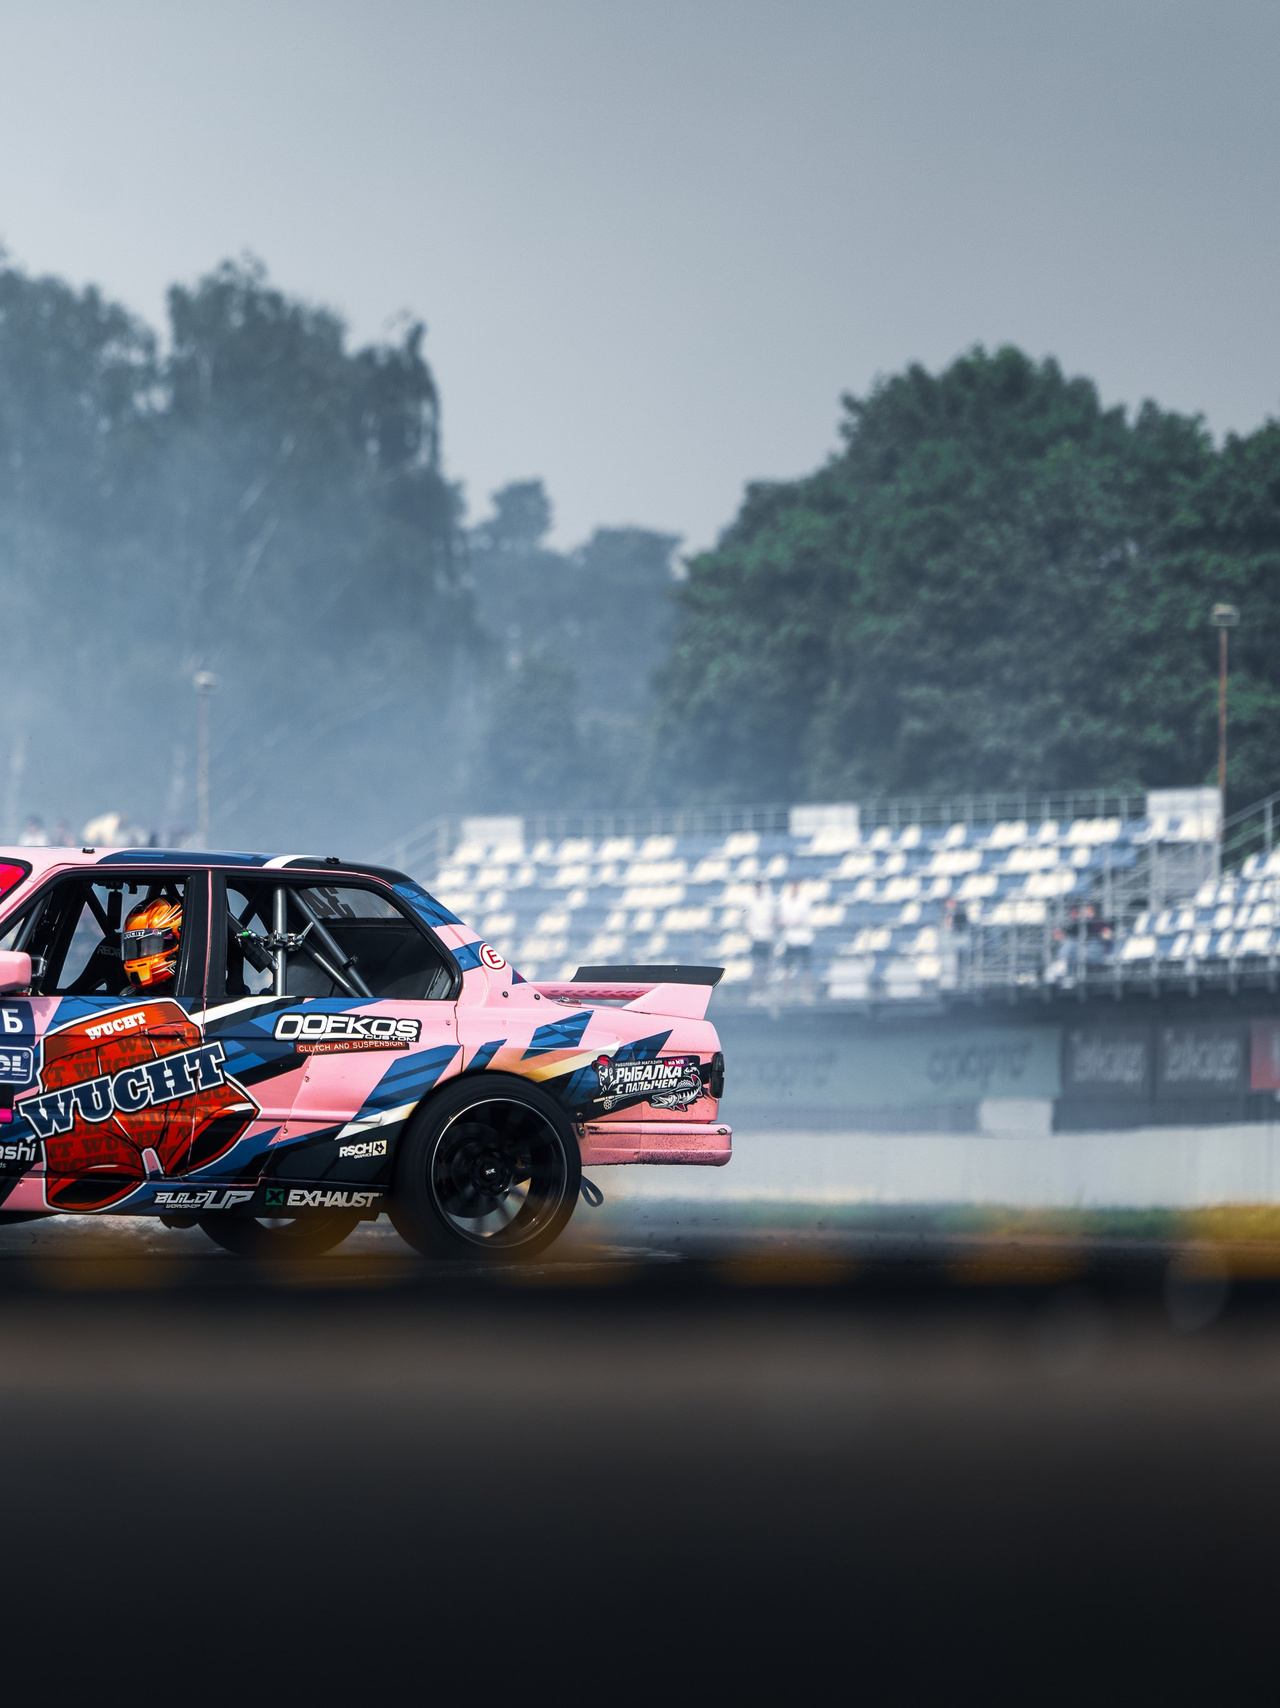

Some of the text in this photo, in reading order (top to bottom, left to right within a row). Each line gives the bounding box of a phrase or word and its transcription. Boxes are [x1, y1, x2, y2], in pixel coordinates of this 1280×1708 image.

[84, 1012, 147, 1040] WUCHT
[364, 1034, 417, 1042] CUSTOM
[298, 1041, 404, 1053] CLUTCH AND SUSPENSION
[615, 1064, 682, 1084] РЫБАЛКА
[18, 1041, 226, 1139] WUCHT
[616, 1078, 678, 1094] С ПАЛЫЧЕМ
[339, 1142, 373, 1158] RSCH
[286, 1189, 380, 1208] EXHAUST
